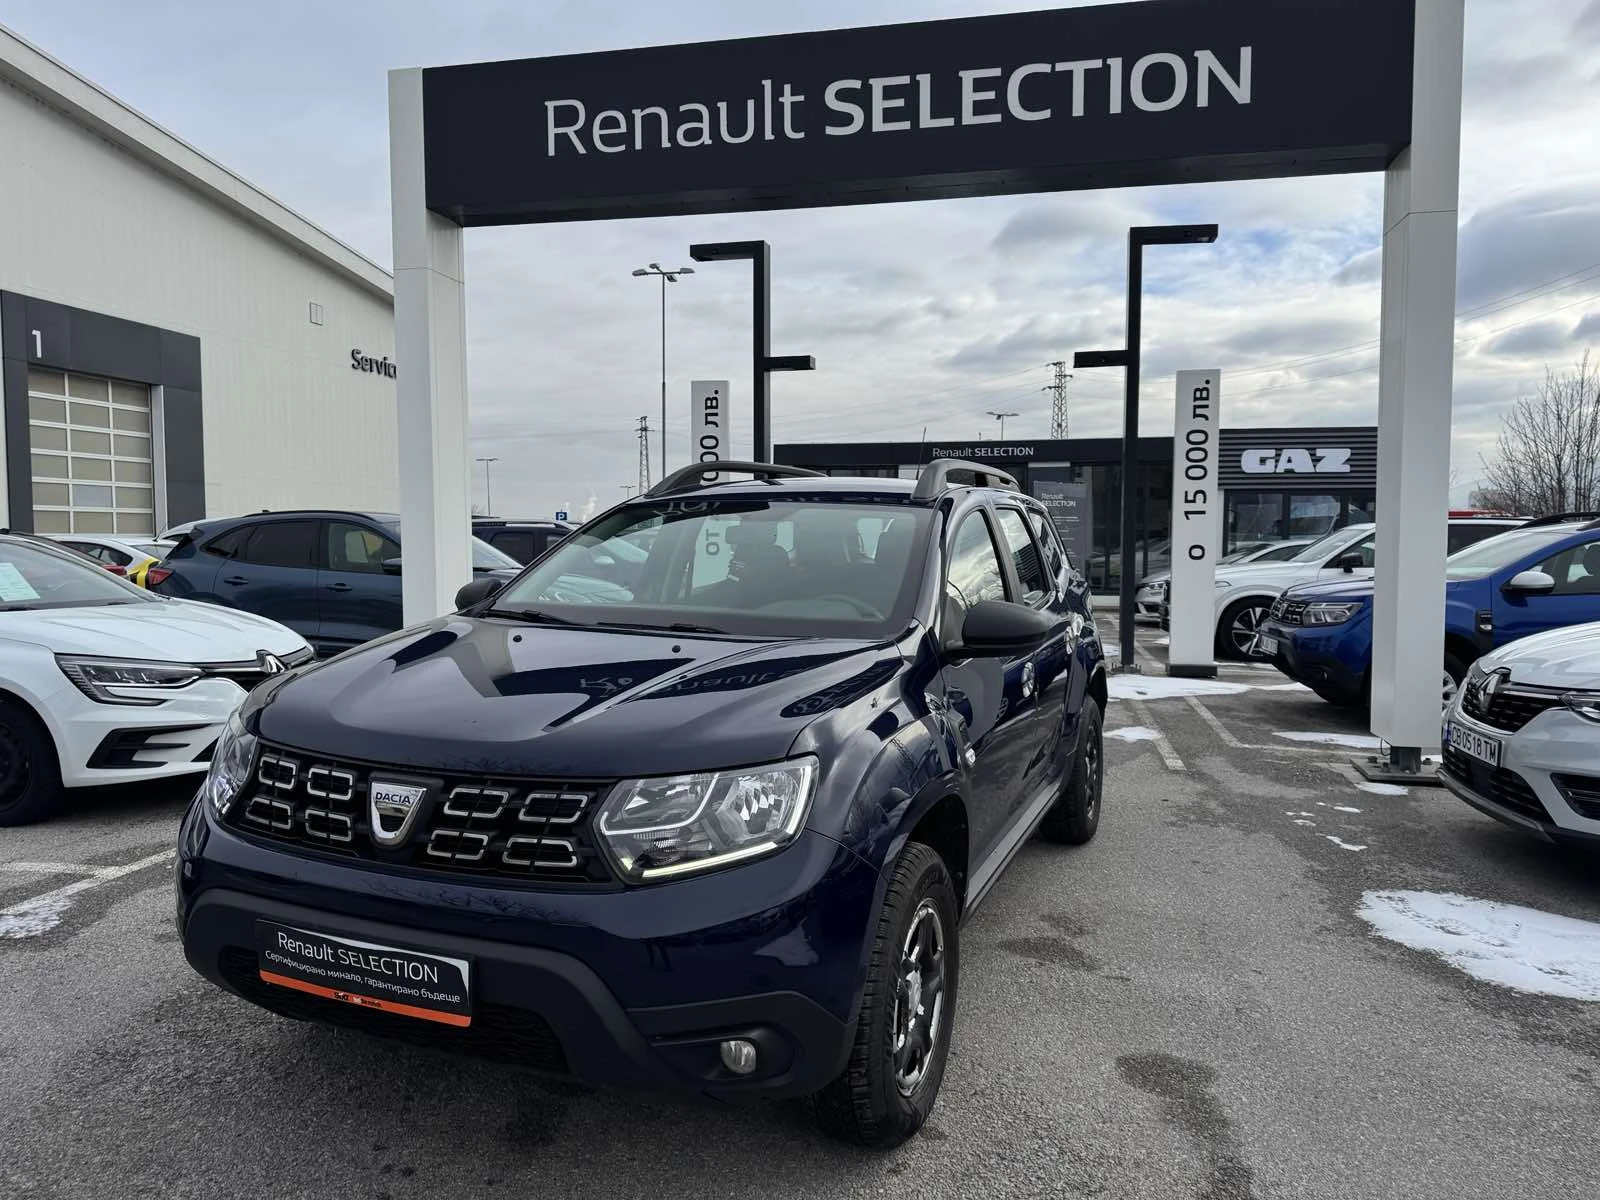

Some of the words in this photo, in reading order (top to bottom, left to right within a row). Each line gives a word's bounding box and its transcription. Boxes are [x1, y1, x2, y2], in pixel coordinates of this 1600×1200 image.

[544, 79, 805, 157] Renault
[824, 46, 1252, 136] SELECTION
[31, 329, 42, 358] 1
[704, 389, 719, 428] лв.
[1193, 379, 1211, 421] лв.
[932, 447, 973, 457] Renault
[974, 446, 1034, 457] SELECTION
[1185, 429, 1209, 481] 000
[1240, 448, 1352, 473] GAZ
[1183, 489, 1208, 521] 15
[1463, 731, 1481, 755] 0518
[1484, 740, 1497, 763] TM
[375, 791, 411, 805] DACIA
[277, 931, 336, 963] Renault
[337, 948, 438, 984] SELECTION
[265, 950, 326, 977] Сертифицирано
[327, 969, 365, 985] минало,
[364, 976, 420, 996] гарантирано
[420, 987, 461, 1004] бъдеще
